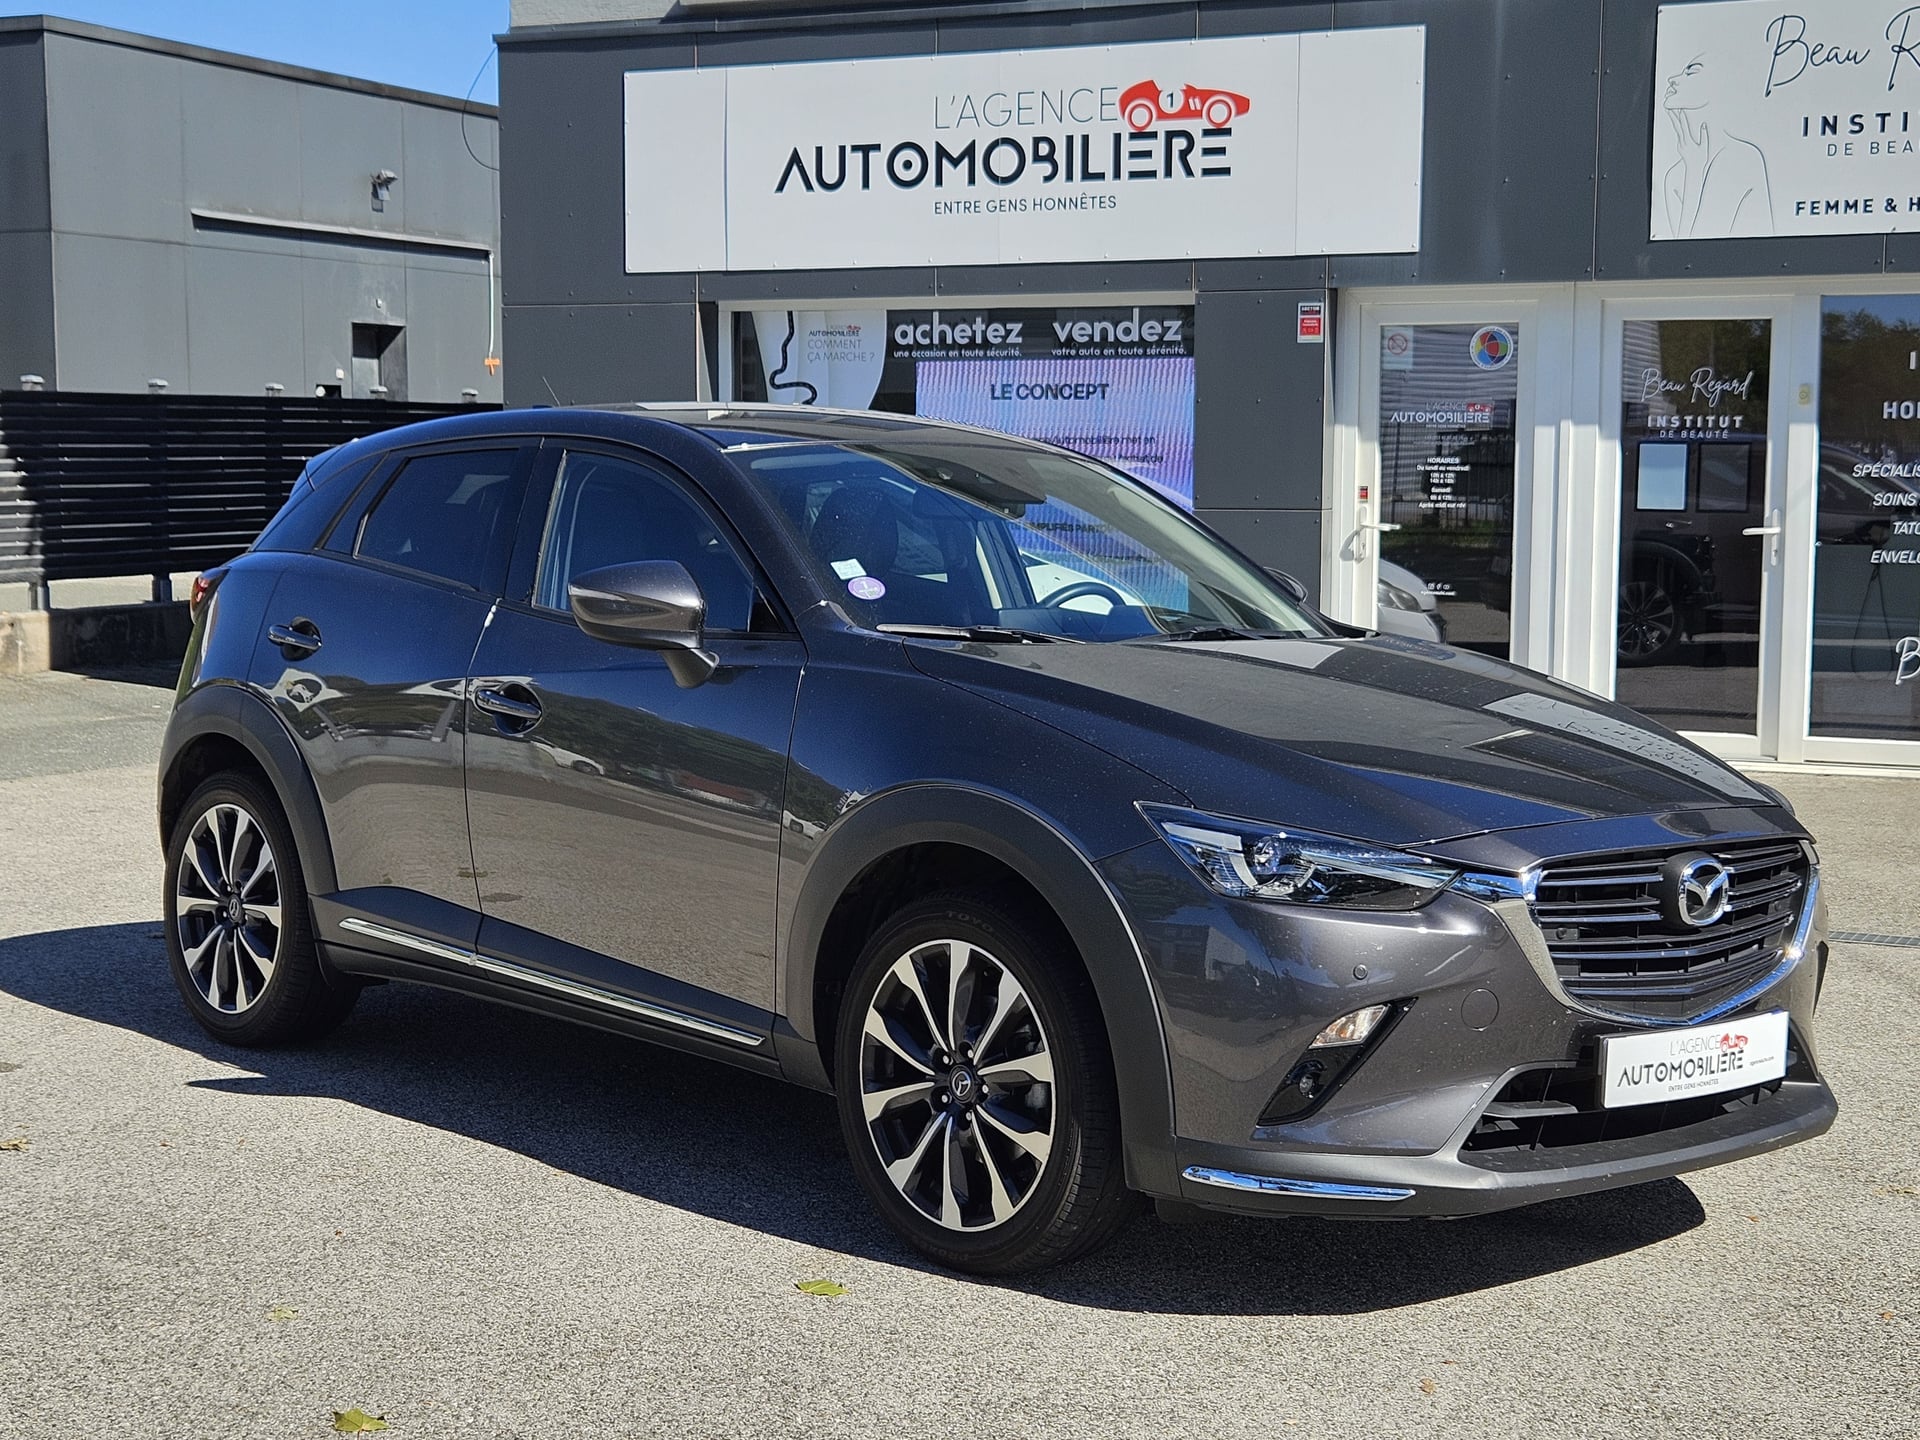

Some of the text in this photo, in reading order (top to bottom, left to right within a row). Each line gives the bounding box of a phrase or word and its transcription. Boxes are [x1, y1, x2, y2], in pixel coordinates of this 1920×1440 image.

[1765, 15, 1870, 97] Beau
[934, 86, 1119, 129] L'AGENCE
[1166, 91, 1175, 109] 1
[1802, 111, 1909, 137] INSTI
[1826, 140, 1914, 157] DE BEA
[934, 192, 1117, 215] ENTRE GENS HONNÊTES
[1794, 196, 1920, 216] FEMME & H
[894, 311, 1023, 345] achetez
[1052, 307, 1182, 343] vendez
[807, 338, 862, 350] COMMENT
[893, 346, 1022, 358] une occasion en toute sécurité.
[1051, 344, 1187, 356] votre auto en toute sérénité.
[807, 351, 876, 364] ÇA MARCHE ?
[990, 383, 1110, 401] LE CONCEPT
[1641, 367, 1755, 408] Beau Regard
[1883, 401, 1920, 419] HO
[1647, 415, 1744, 428] INSTITUT
[1659, 430, 1675, 439] DE
[1427, 456, 1460, 464] HORAIRES
[1873, 492, 1917, 506] SOINS
[1669, 1033, 1722, 1057] L'AGENCE
